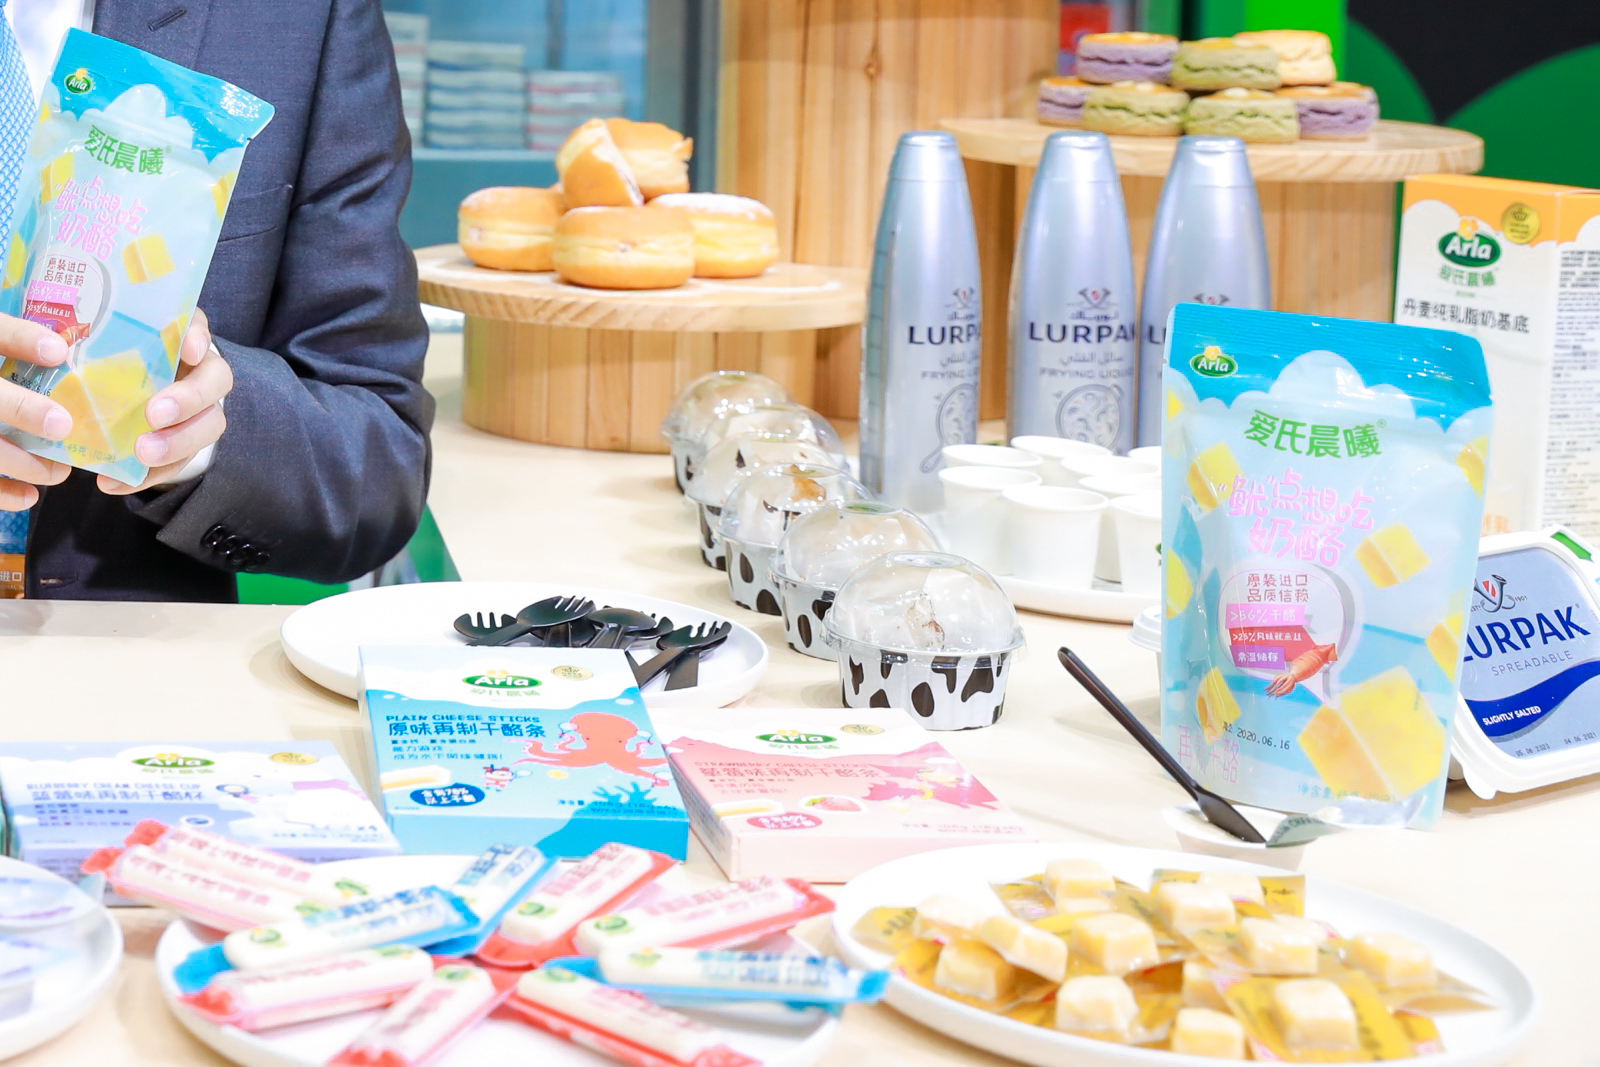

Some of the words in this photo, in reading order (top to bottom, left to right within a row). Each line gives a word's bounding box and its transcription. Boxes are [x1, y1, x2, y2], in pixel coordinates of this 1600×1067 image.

[68, 77, 88, 91] Arla
[84, 124, 165, 175] 爱氏晨曦
[56, 213, 118, 260] 奶酪
[1445, 236, 1493, 260] Arla
[47, 257, 87, 274] 原装进口
[44, 270, 85, 287] 品质信赖
[1197, 358, 1230, 373] Arla
[1244, 409, 1382, 459] 爱氏晨曦
[1248, 516, 1345, 567] 奶酪
[1247, 573, 1308, 588] 原装进口
[1247, 588, 1309, 603] 品质信赖
[1491, 650, 1573, 677] SPREADABLE
[474, 676, 530, 686] Arla
[488, 715, 541, 723] STICKS
[1482, 712, 1515, 726] SLIGHTLY
[1514, 705, 1542, 719] SALTED
[388, 722, 546, 738] 原味再制干酪条
[768, 734, 824, 743] Arla
[1236, 727, 1291, 750] 2020.06.16
[144, 757, 201, 766] Arla
[93, 782, 131, 790] CREAM
